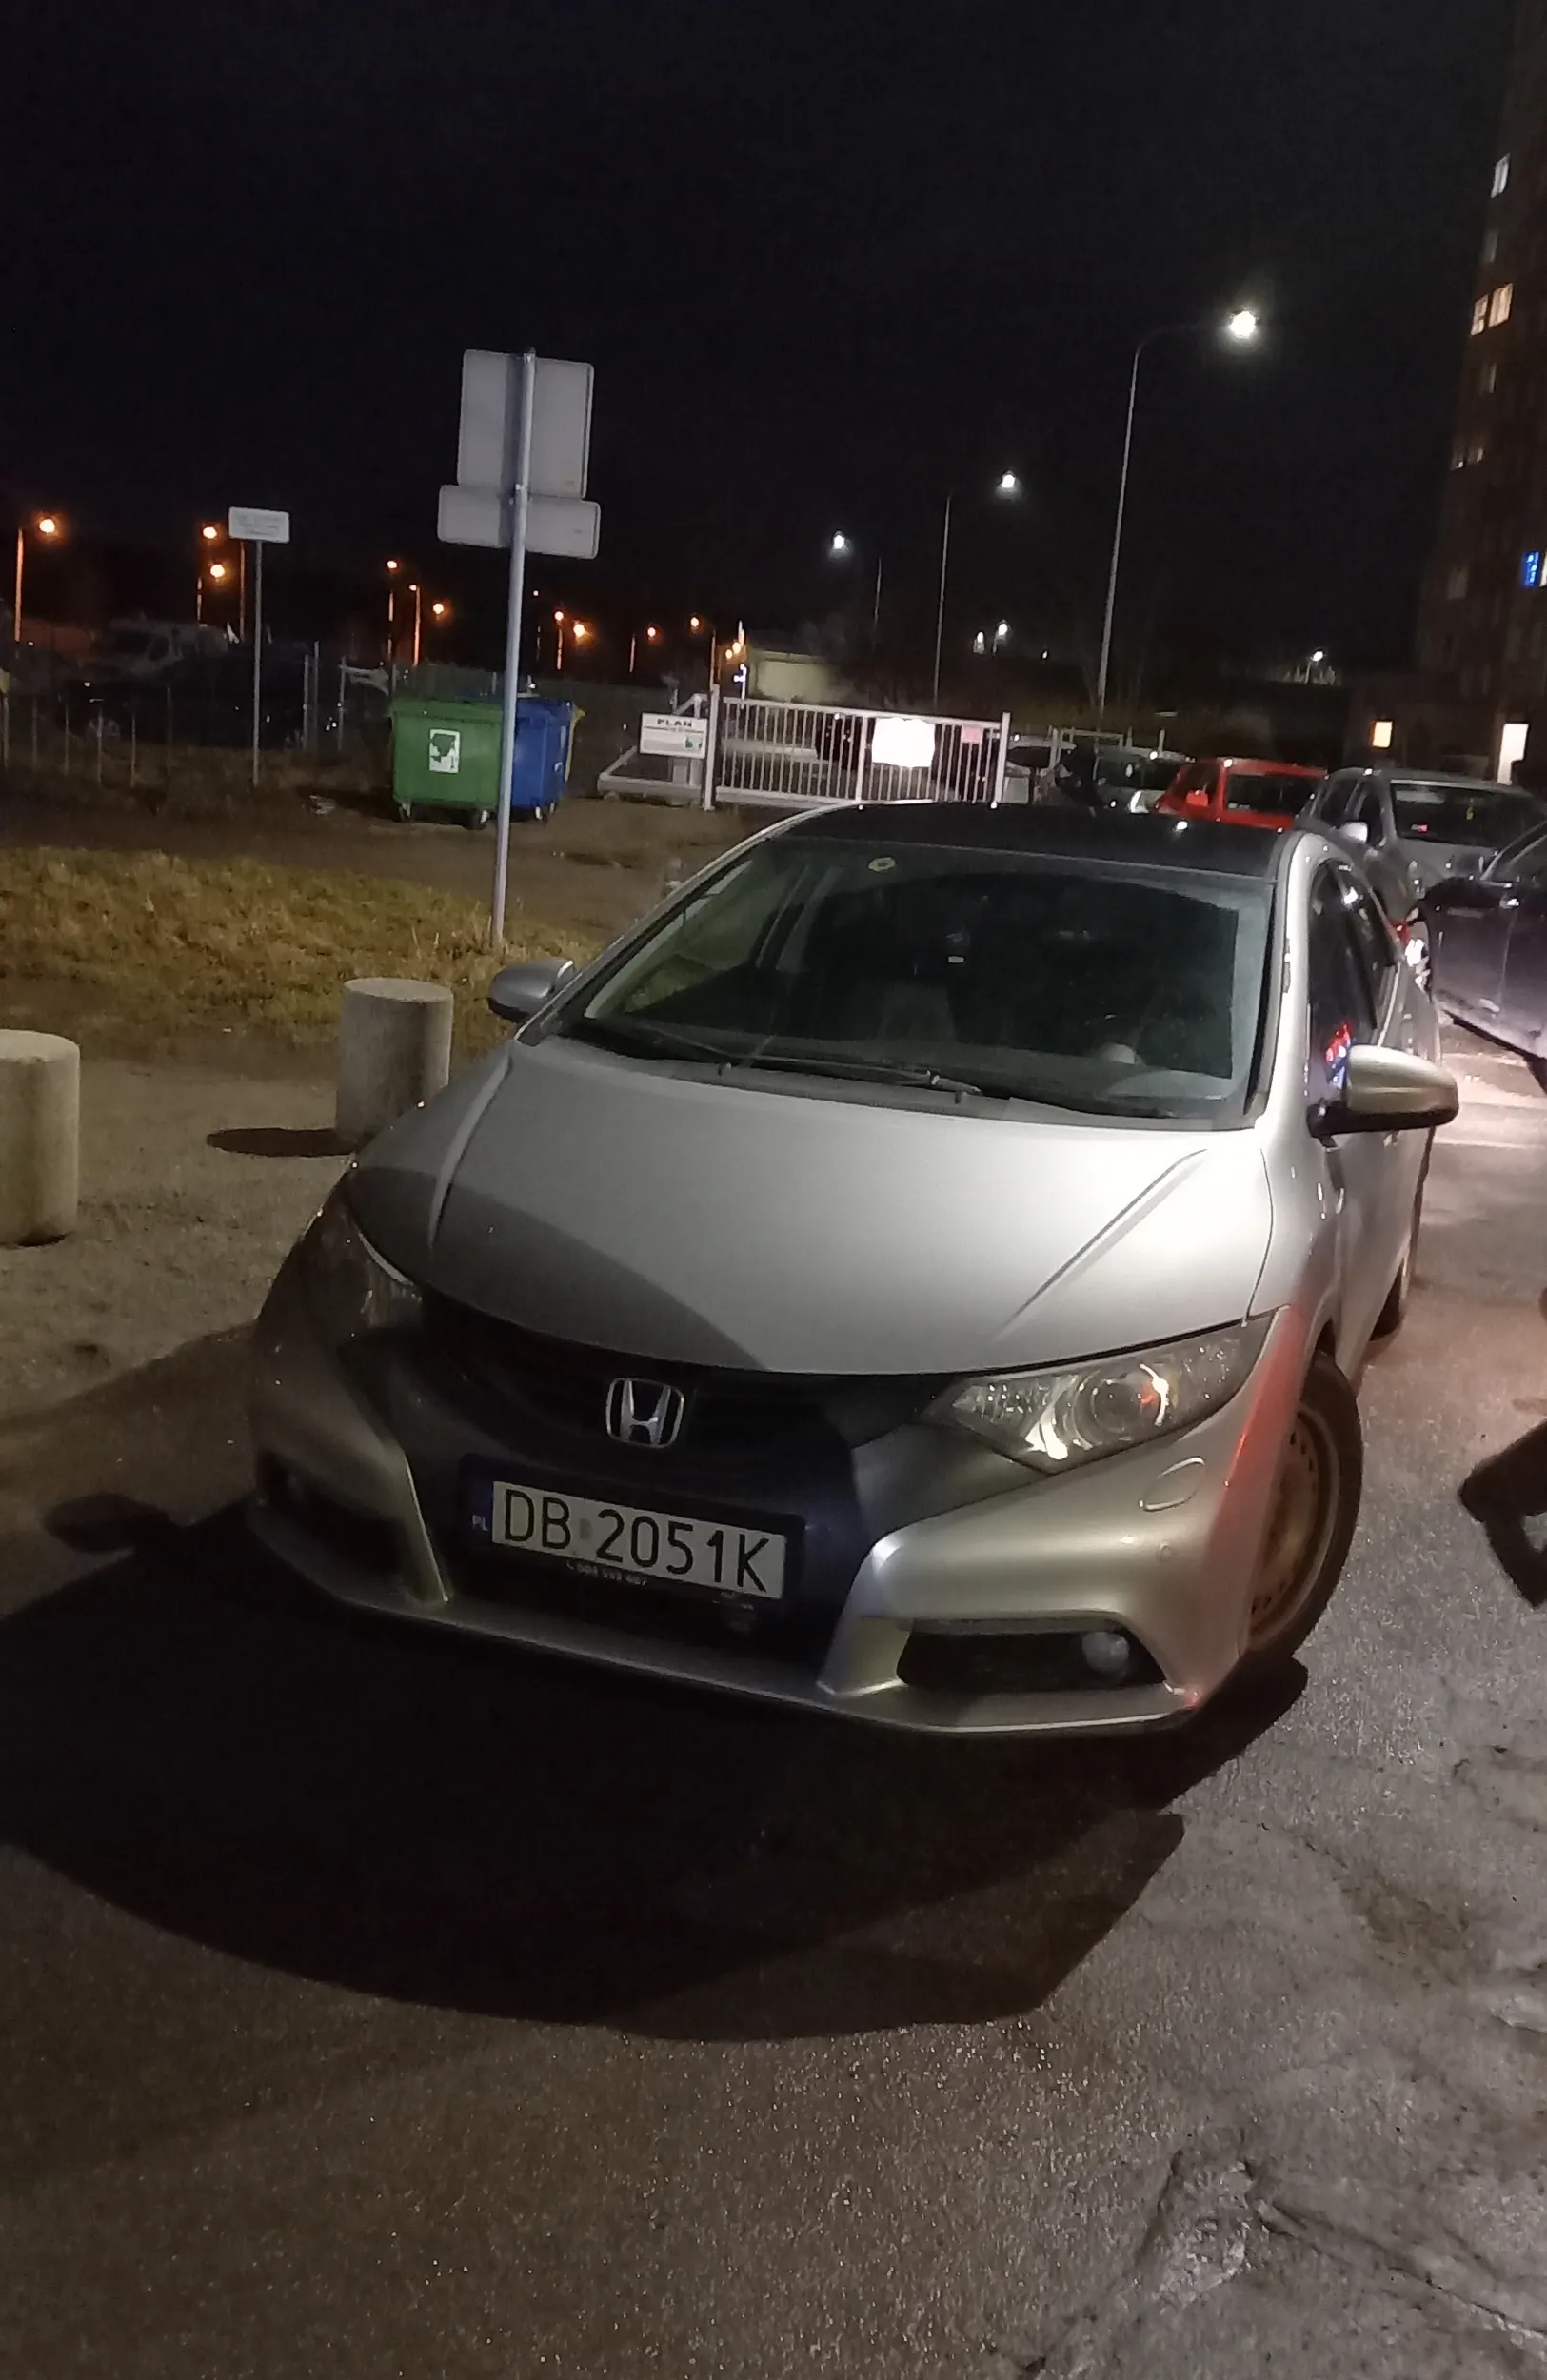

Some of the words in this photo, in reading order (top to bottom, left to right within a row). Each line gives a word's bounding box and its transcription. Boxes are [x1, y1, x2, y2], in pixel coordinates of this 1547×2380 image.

[472, 1514, 488, 1532] PL
[505, 1489, 571, 1550] DB
[596, 1508, 769, 1593] 2051K
